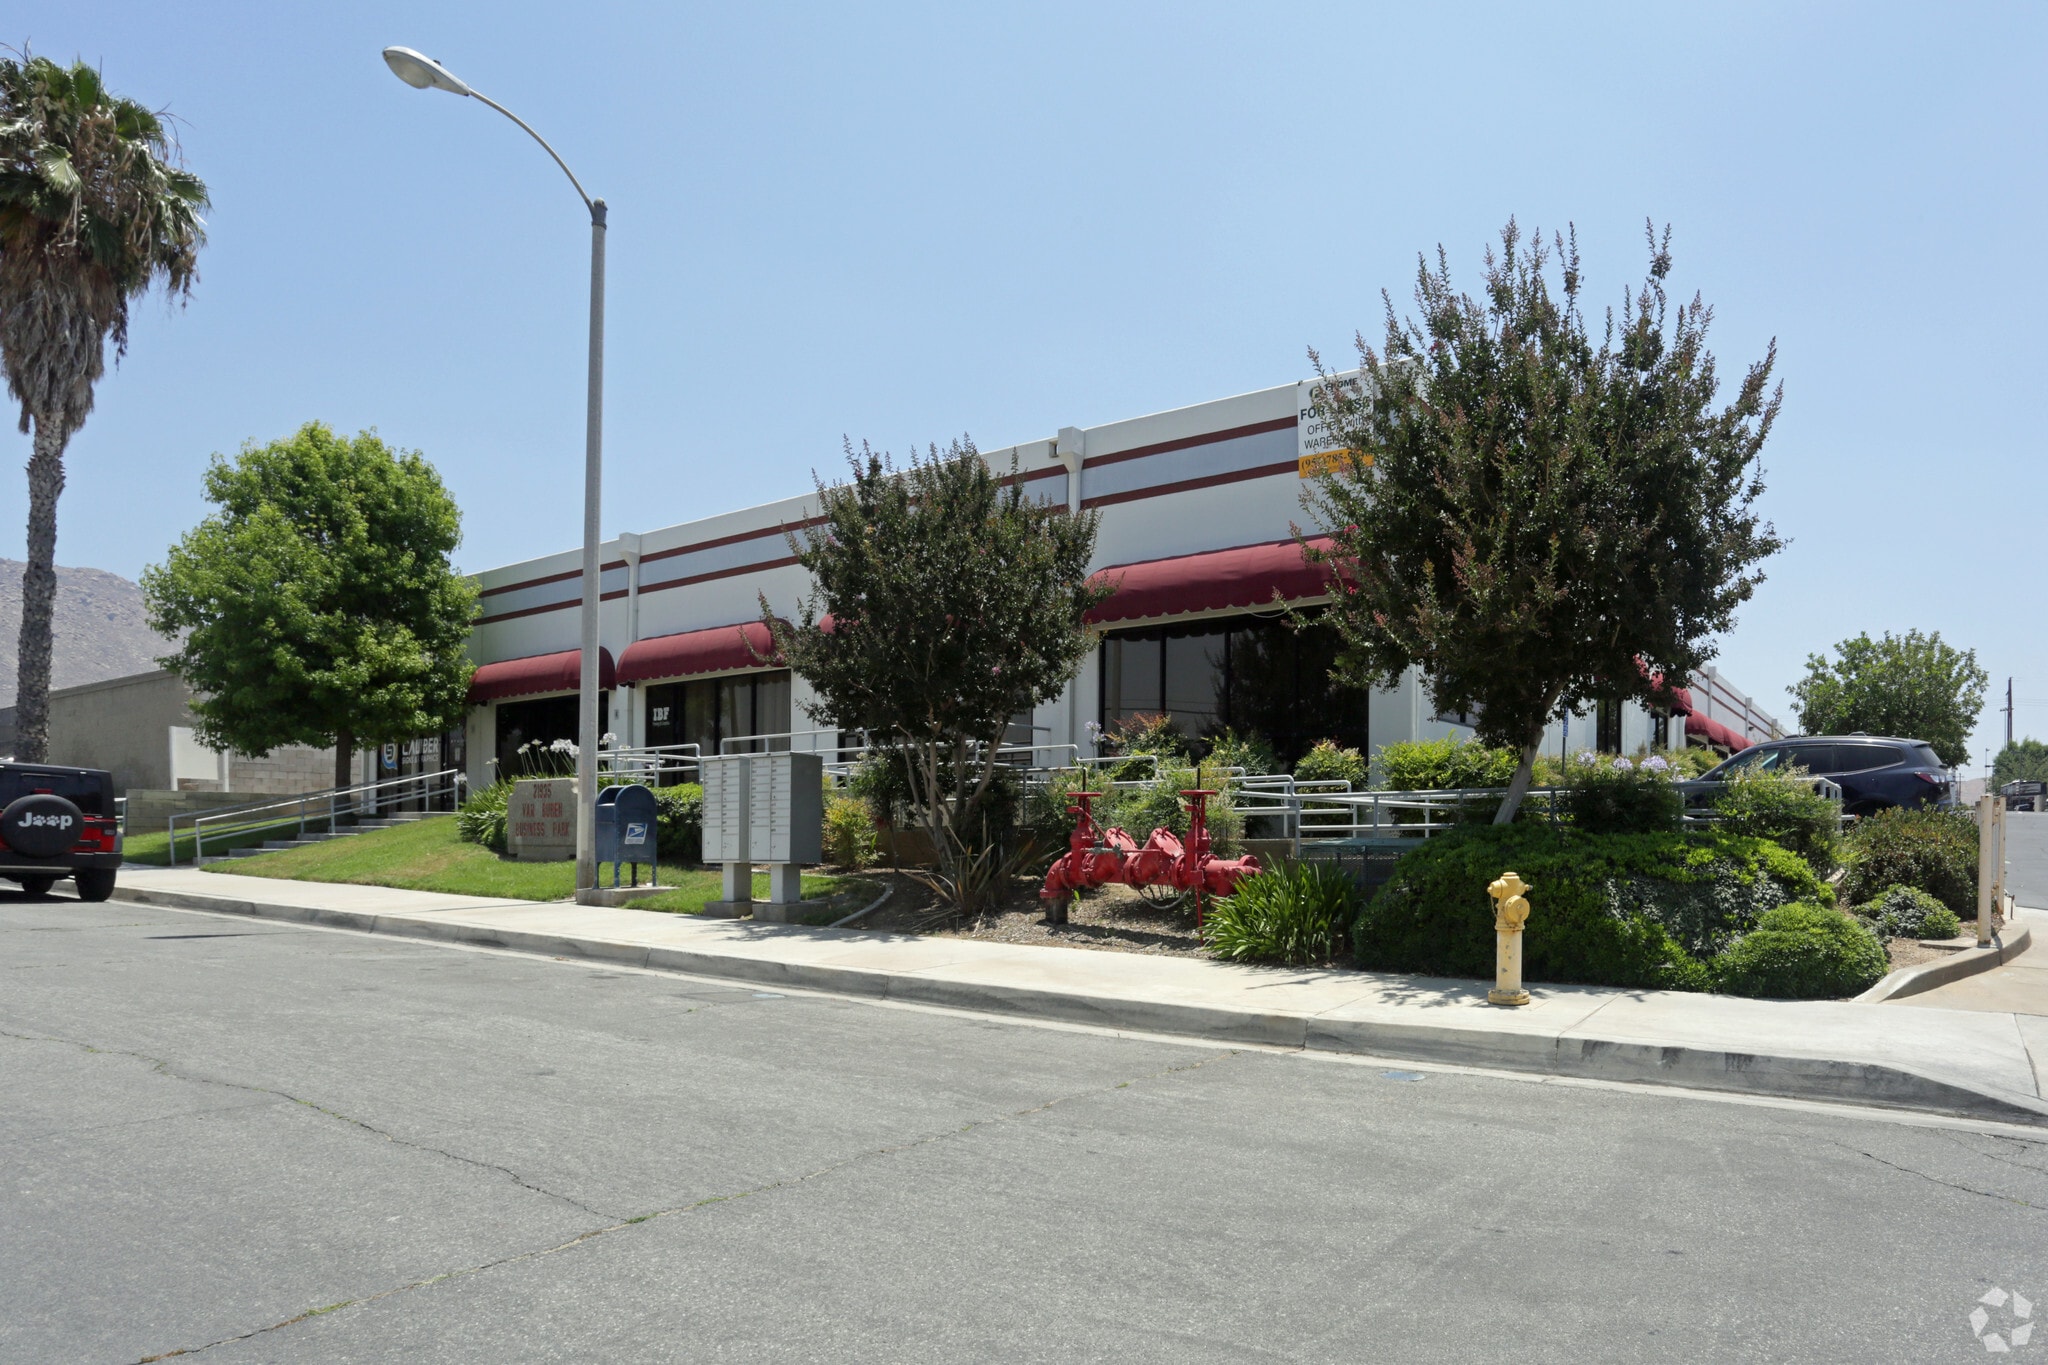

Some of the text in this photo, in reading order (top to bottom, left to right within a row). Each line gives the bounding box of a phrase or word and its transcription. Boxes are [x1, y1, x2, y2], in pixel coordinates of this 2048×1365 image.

[1300, 405, 1325, 420] FOR
[653, 706, 670, 721] IBF
[402, 737, 439, 755] CALBER
[522, 802, 563, 817] VAN BUREN
[515, 822, 570, 837] BUSINESS PARK
